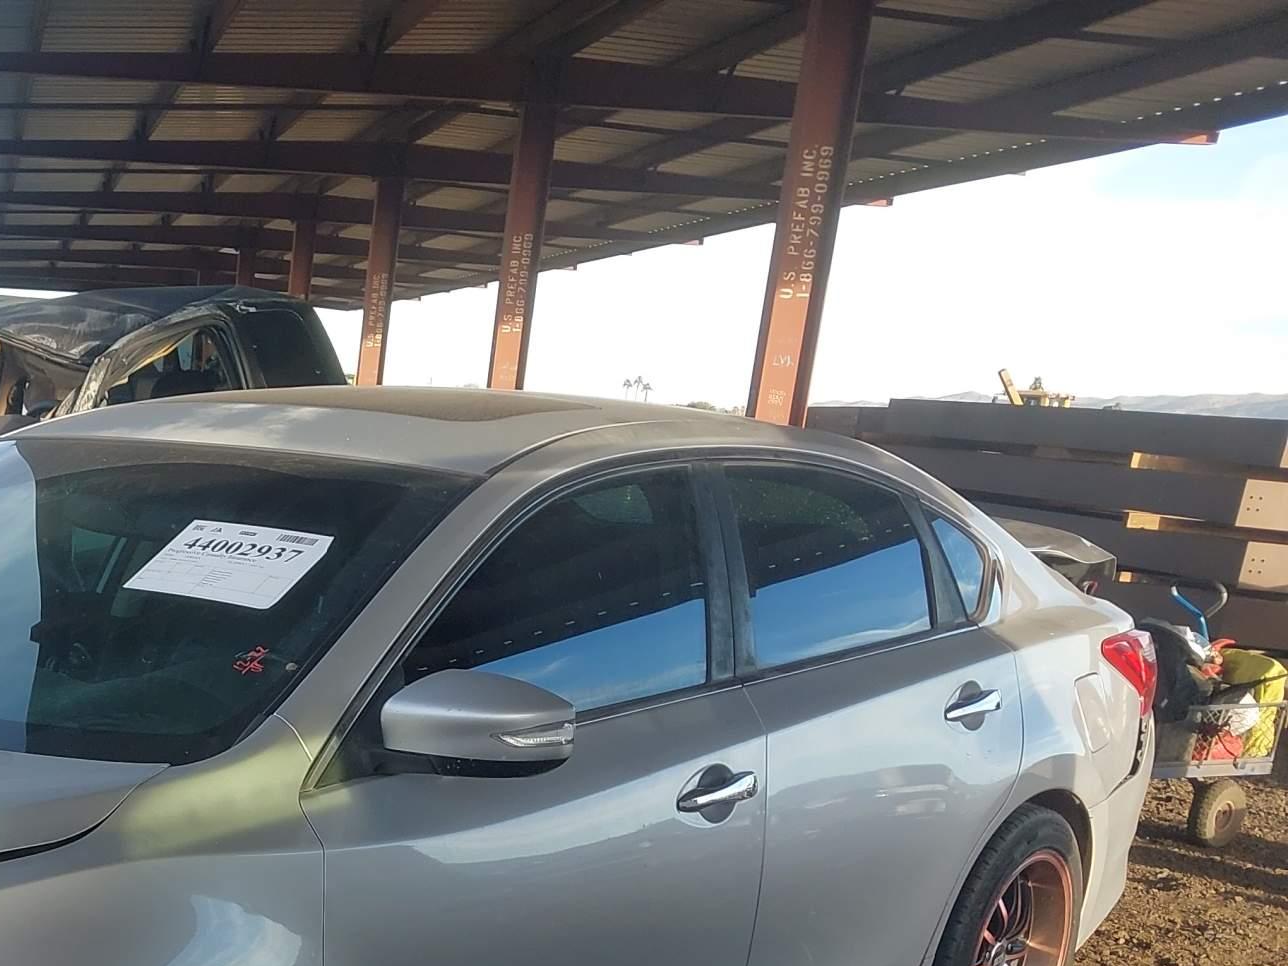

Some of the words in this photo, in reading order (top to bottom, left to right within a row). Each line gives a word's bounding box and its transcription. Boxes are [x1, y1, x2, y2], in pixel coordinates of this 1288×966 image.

[786, 186, 811, 256] PREFAB
[799, 144, 819, 177] INC.
[796, 145, 834, 298] 1-866-799-0969
[505, 258, 520, 305] PREFAB
[183, 536, 305, 563] 44002937
